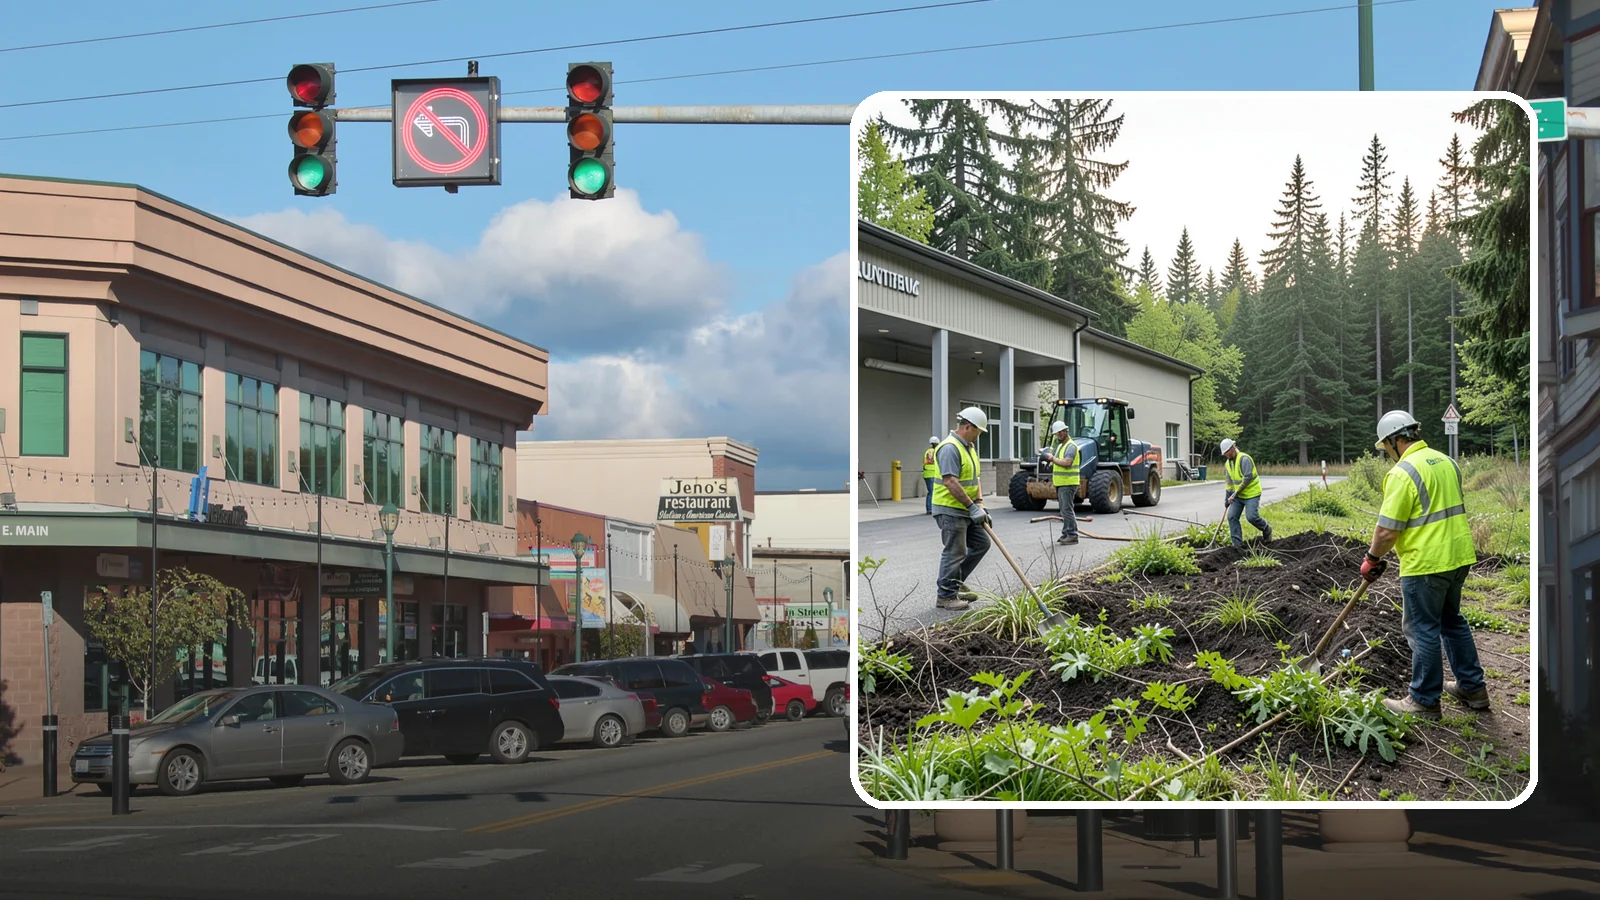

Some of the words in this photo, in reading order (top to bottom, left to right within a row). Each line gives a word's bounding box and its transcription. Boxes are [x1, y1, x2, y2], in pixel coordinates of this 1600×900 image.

[669, 480, 727, 494] Jeno's
[665, 496, 731, 508] restaurant
[658, 509, 682, 519] Italian
[686, 509, 714, 519] American
[715, 509, 738, 519] Cuisine
[2, 525, 13, 536] E.
[15, 525, 49, 536] MAIN
[797, 607, 828, 616] Street
